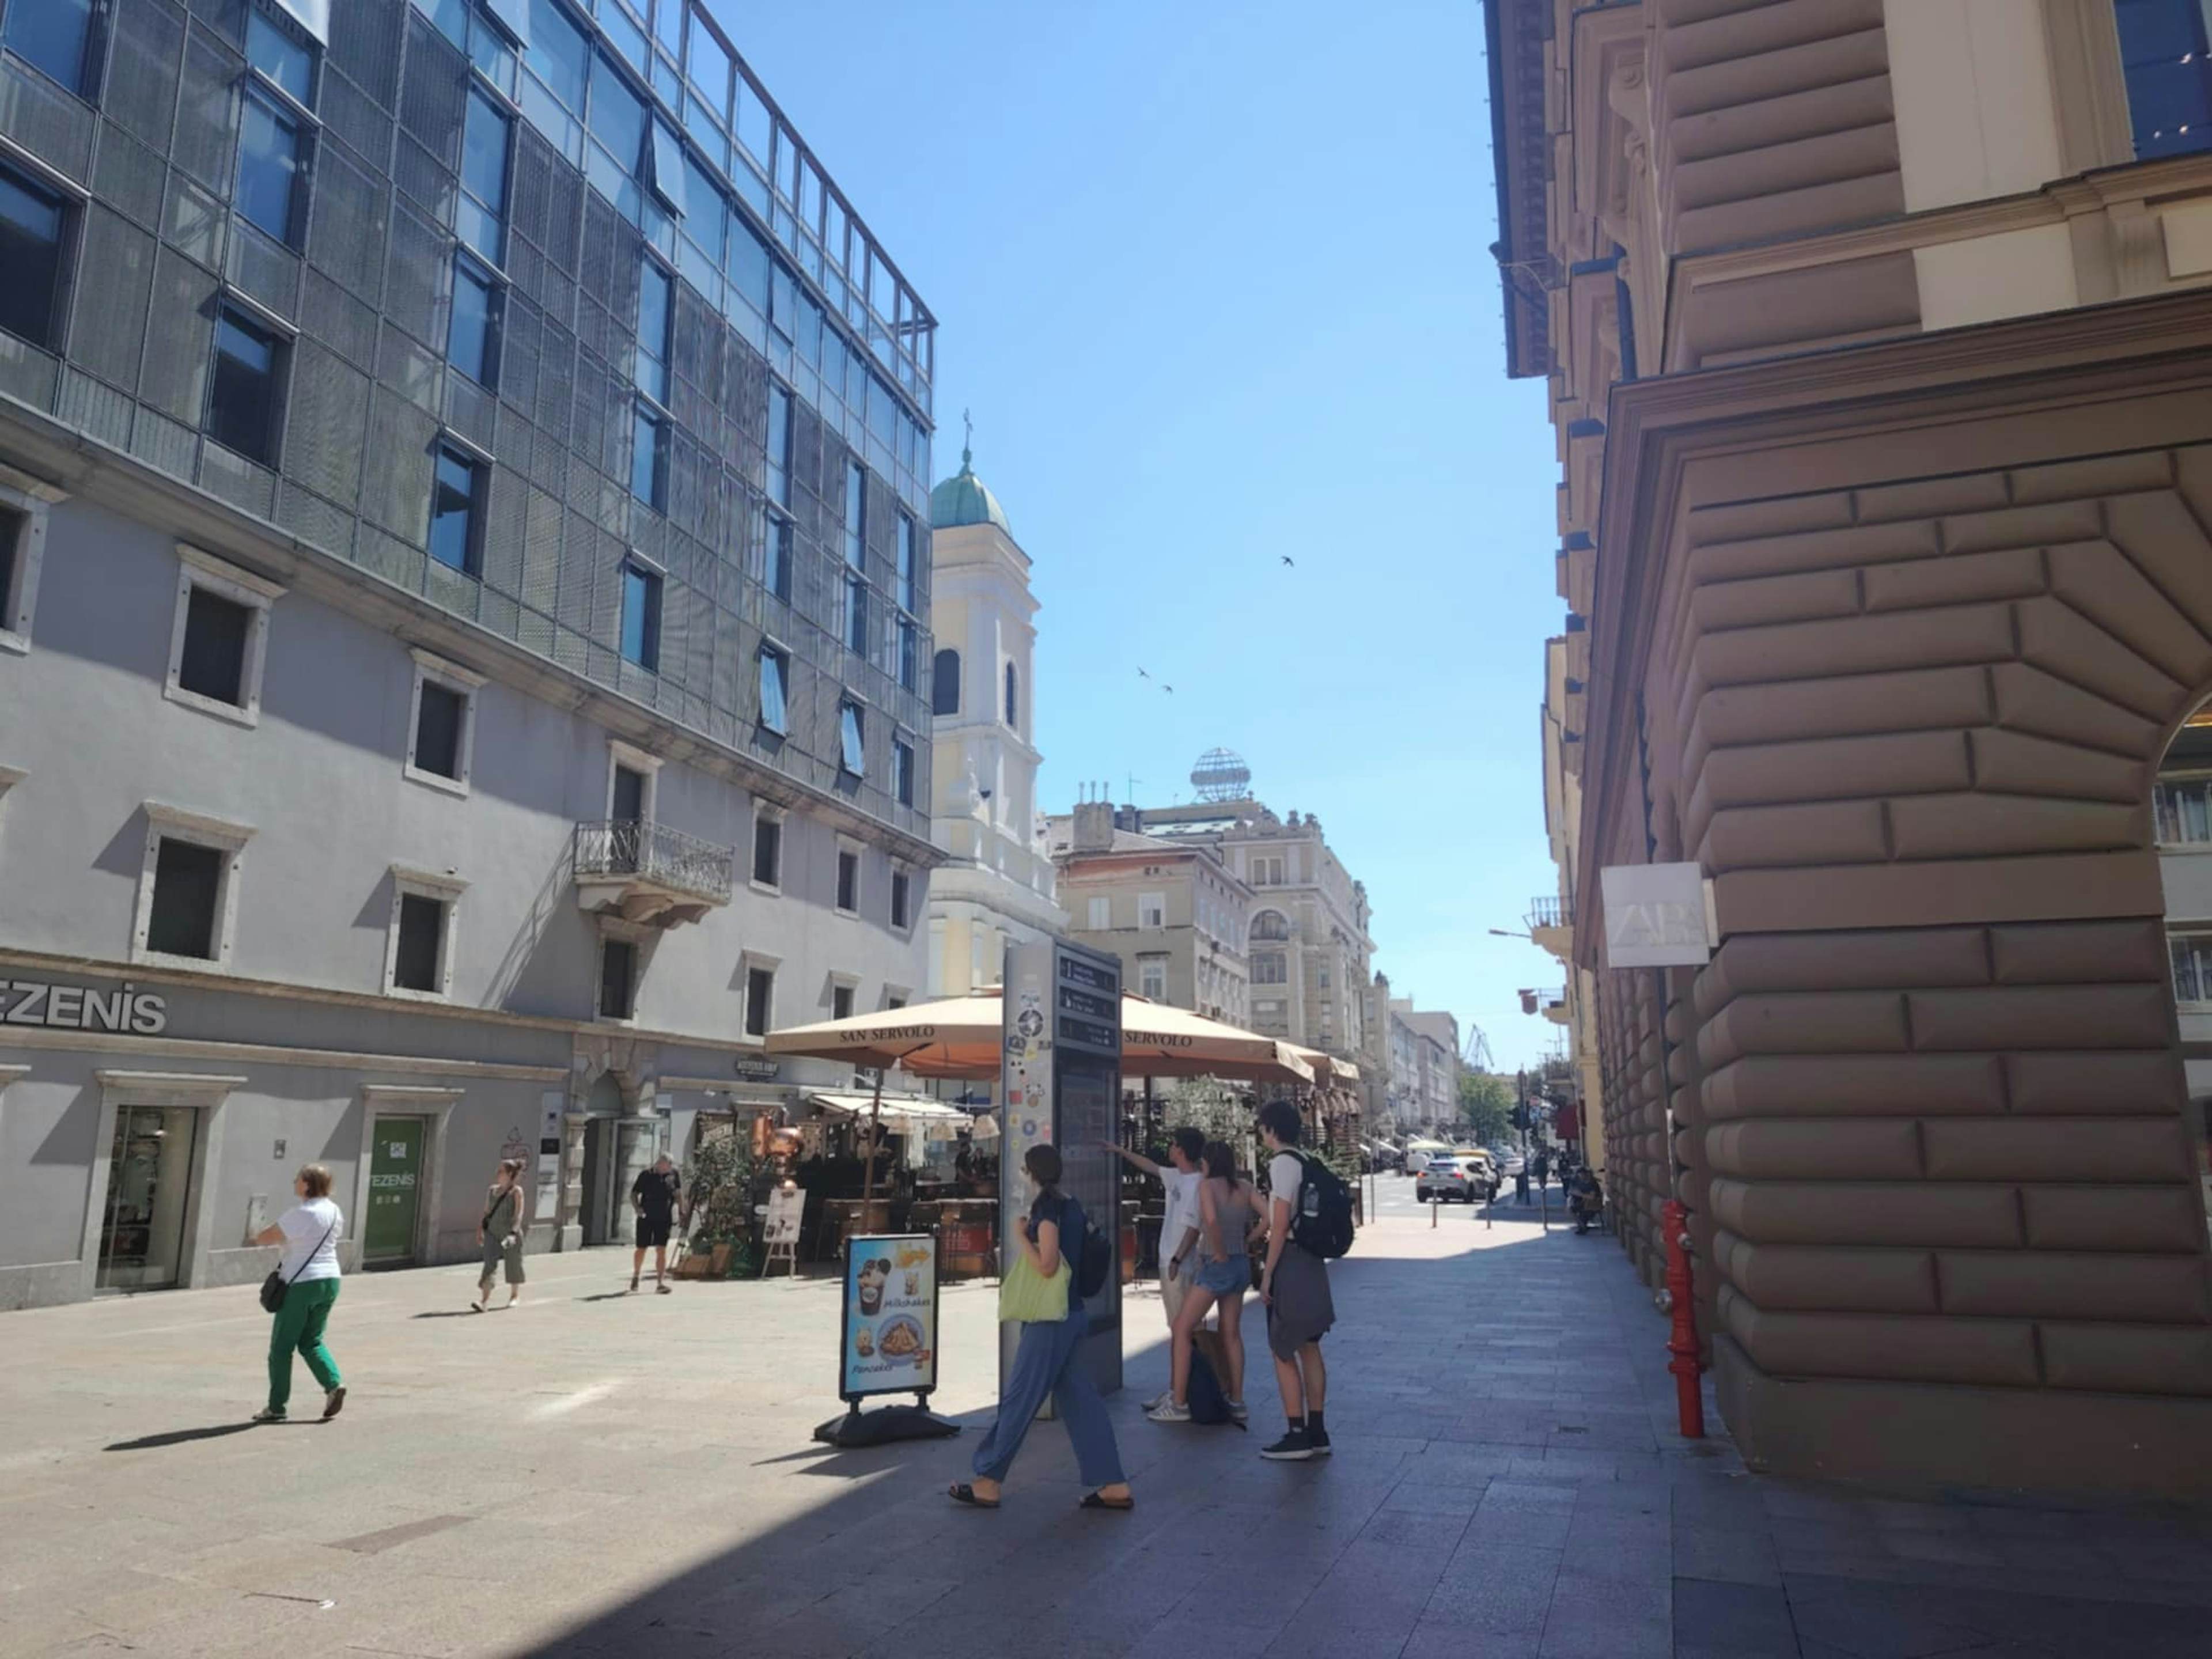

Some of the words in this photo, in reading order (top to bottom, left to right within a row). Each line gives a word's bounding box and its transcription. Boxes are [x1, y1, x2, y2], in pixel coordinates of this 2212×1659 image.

[840, 1030, 866, 1043] SAN
[871, 1026, 935, 1040] SERVOLO
[1124, 1031, 1192, 1047] SERVOLO
